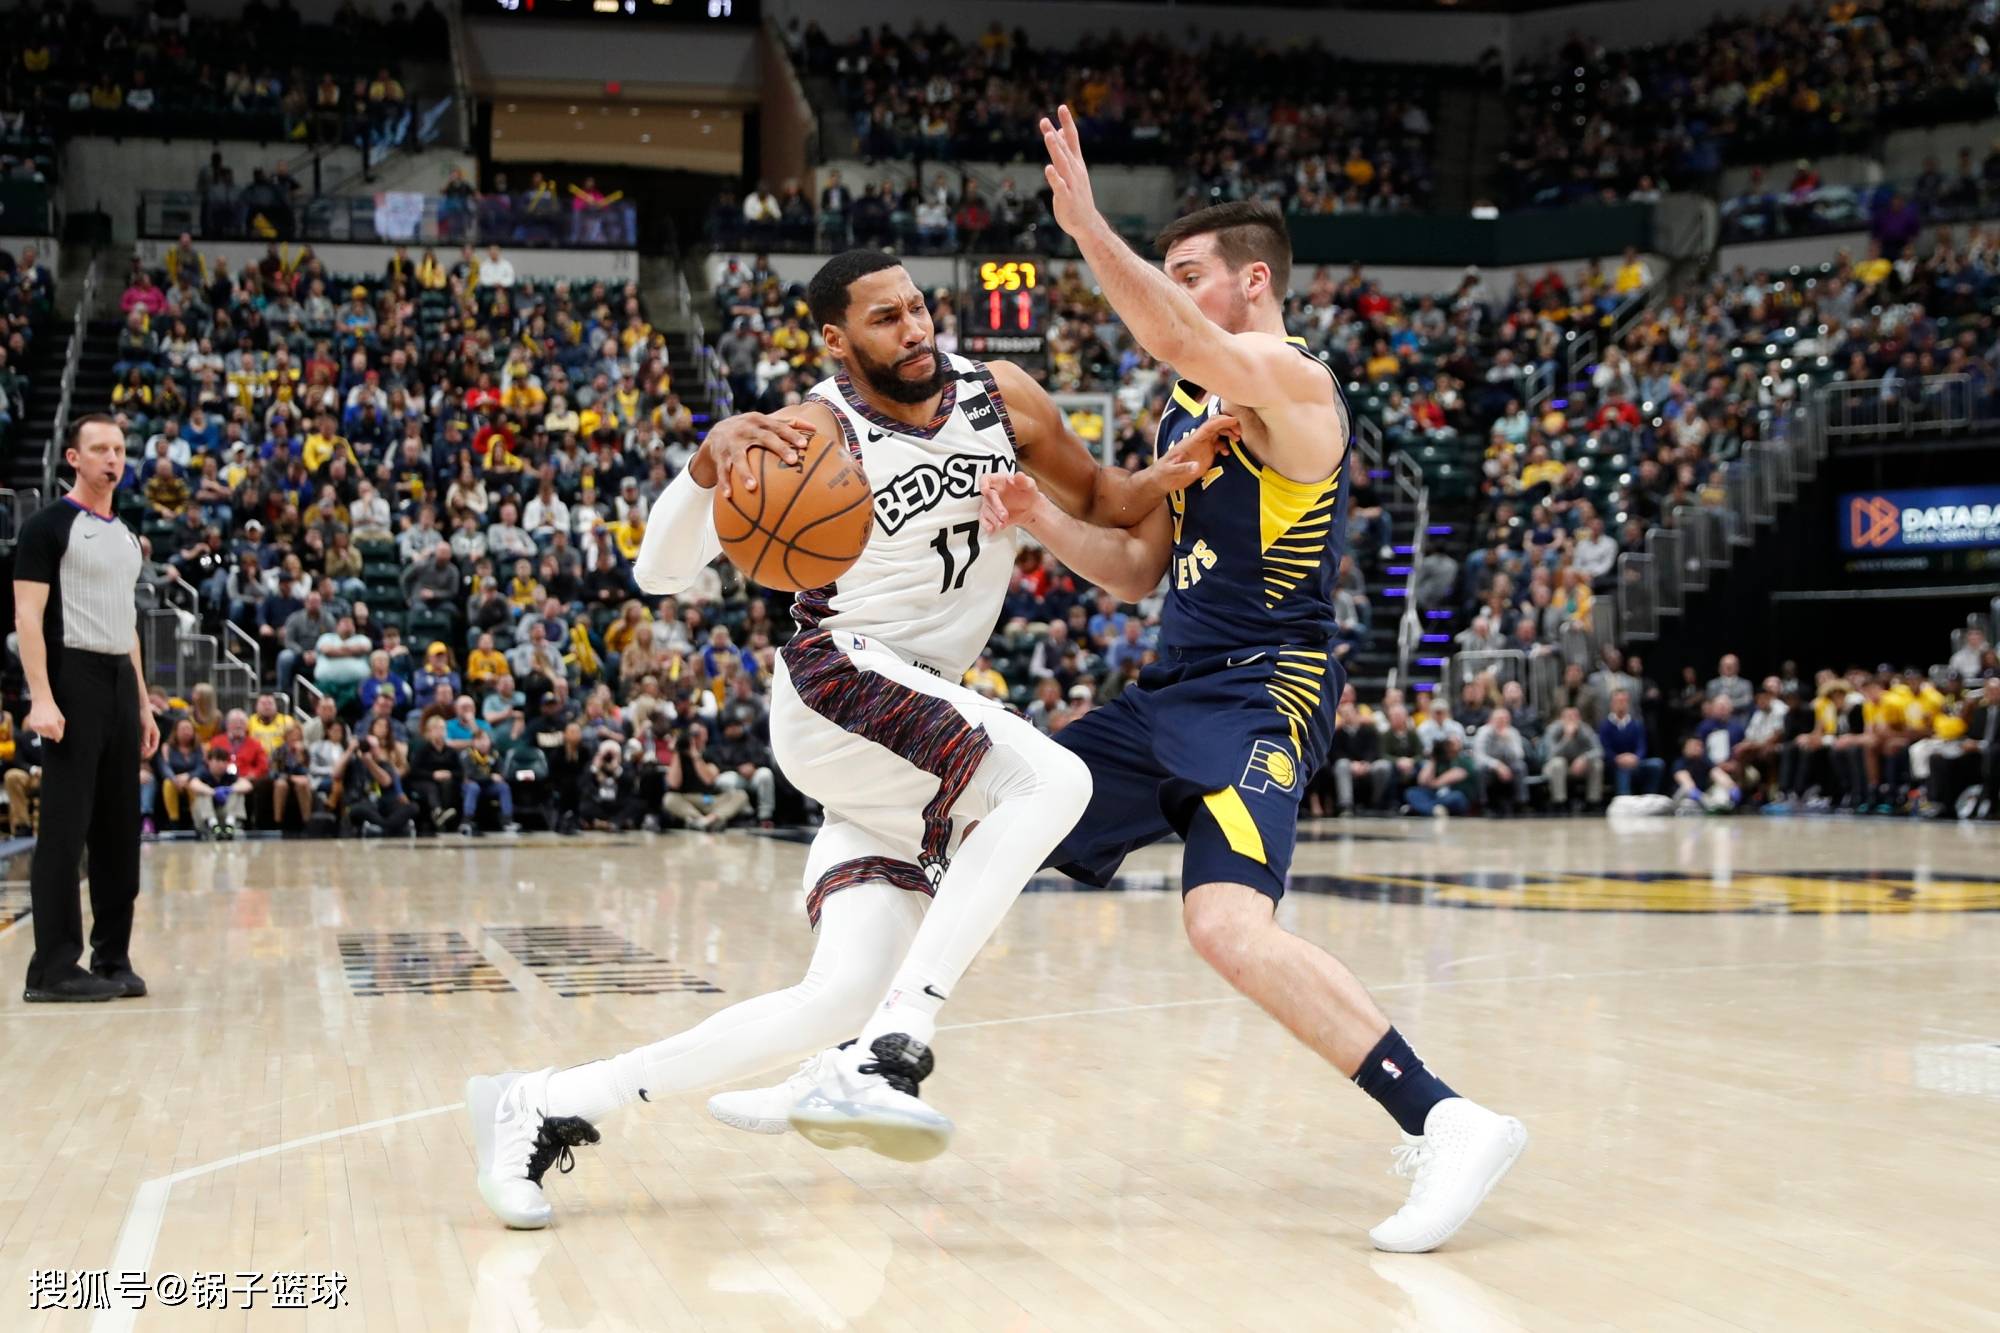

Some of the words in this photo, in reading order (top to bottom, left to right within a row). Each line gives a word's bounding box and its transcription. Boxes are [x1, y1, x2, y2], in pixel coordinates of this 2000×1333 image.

[981, 262, 1036, 290] 5:57
[965, 403, 991, 421] infor
[930, 520, 980, 594] 17
[1173, 539, 1218, 590] ERS
